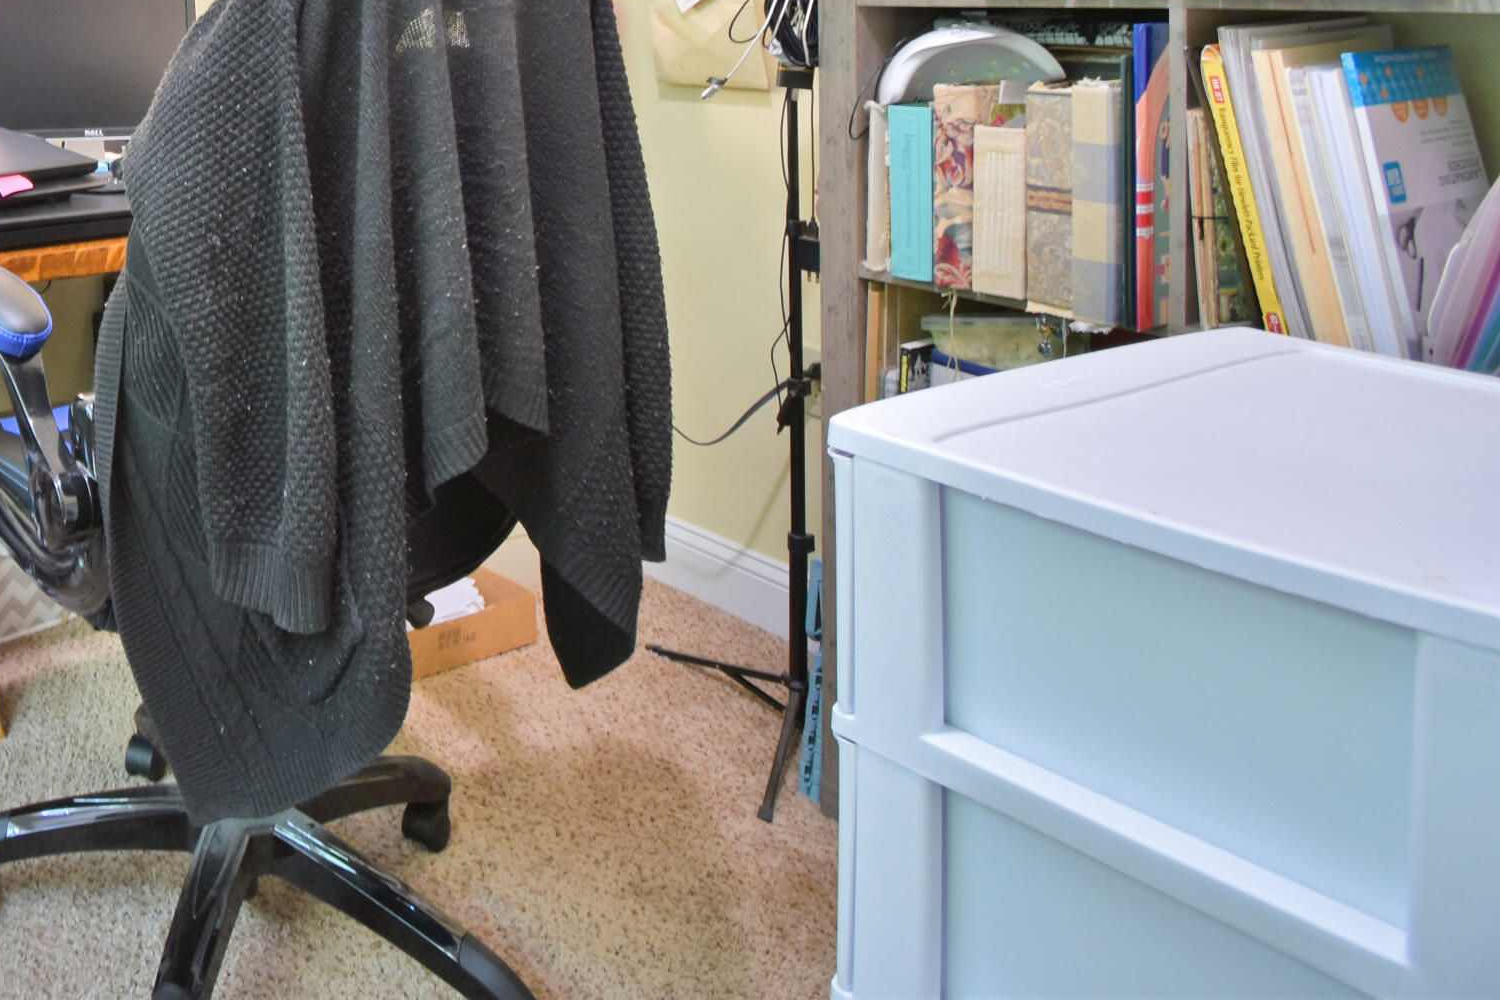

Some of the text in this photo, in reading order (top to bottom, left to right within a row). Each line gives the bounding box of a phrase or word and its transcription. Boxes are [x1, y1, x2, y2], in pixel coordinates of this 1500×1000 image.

[84, 129, 104, 137] DELL
[1217, 107, 1234, 154] Transparency
[1228, 155, 1239, 173] Film
[1237, 188, 1259, 255] Hewlett-Packard
[1252, 256, 1264, 280] Printers
